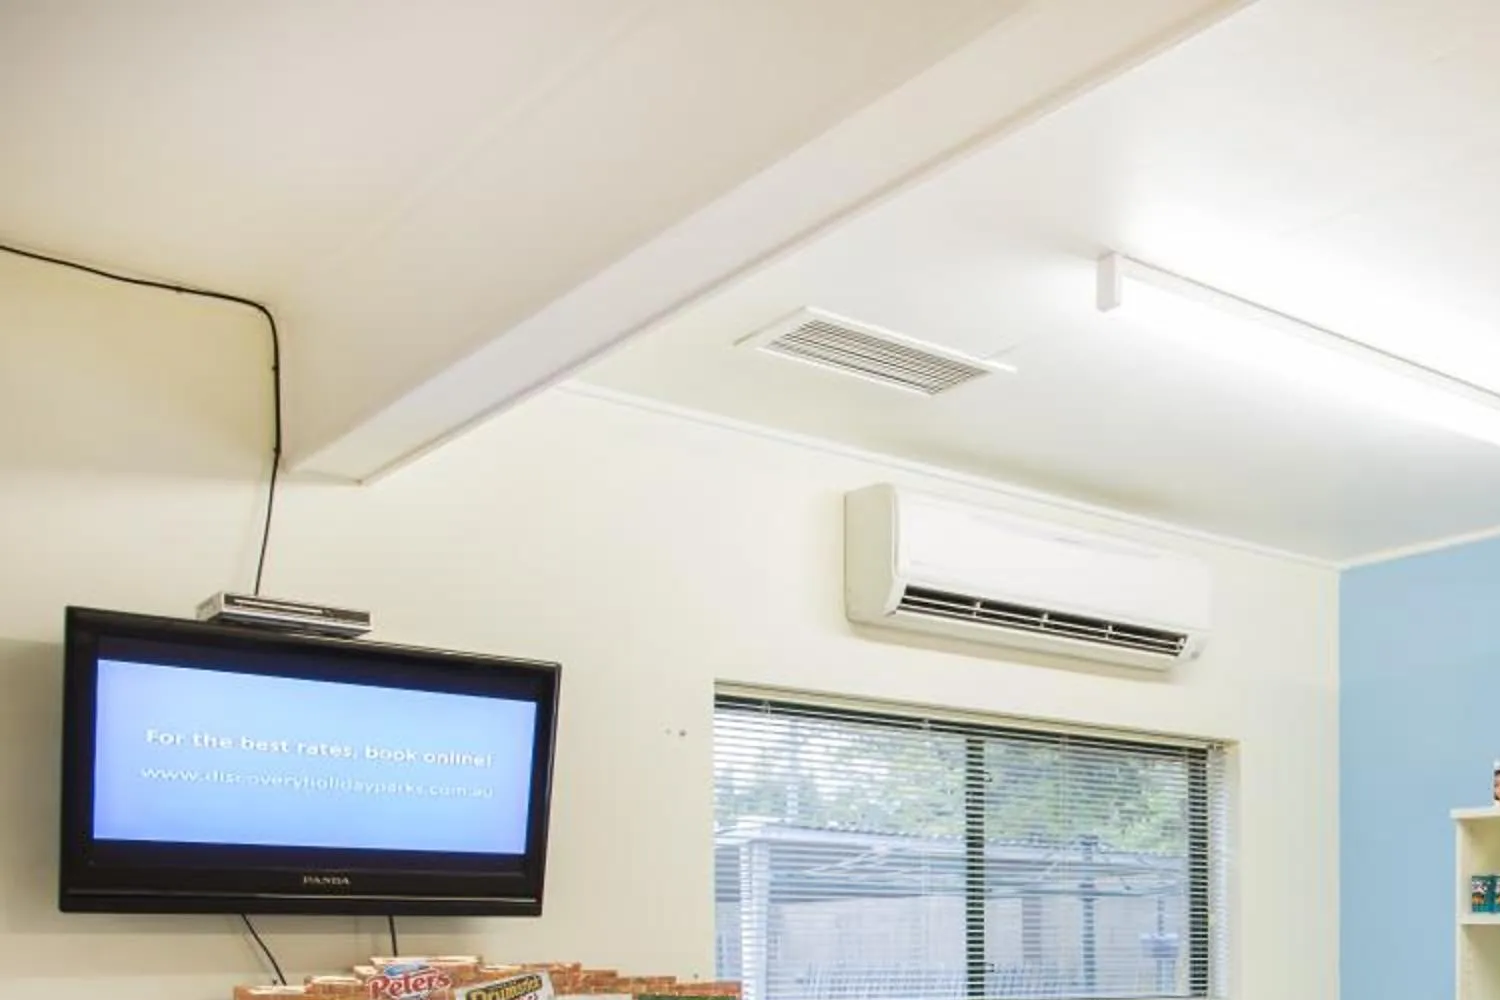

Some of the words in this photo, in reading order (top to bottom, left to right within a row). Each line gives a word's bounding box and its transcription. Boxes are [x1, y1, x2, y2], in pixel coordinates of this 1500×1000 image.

[146, 727, 183, 746] For
[192, 732, 233, 749] the
[241, 735, 289, 754] best
[365, 744, 417, 762] book
